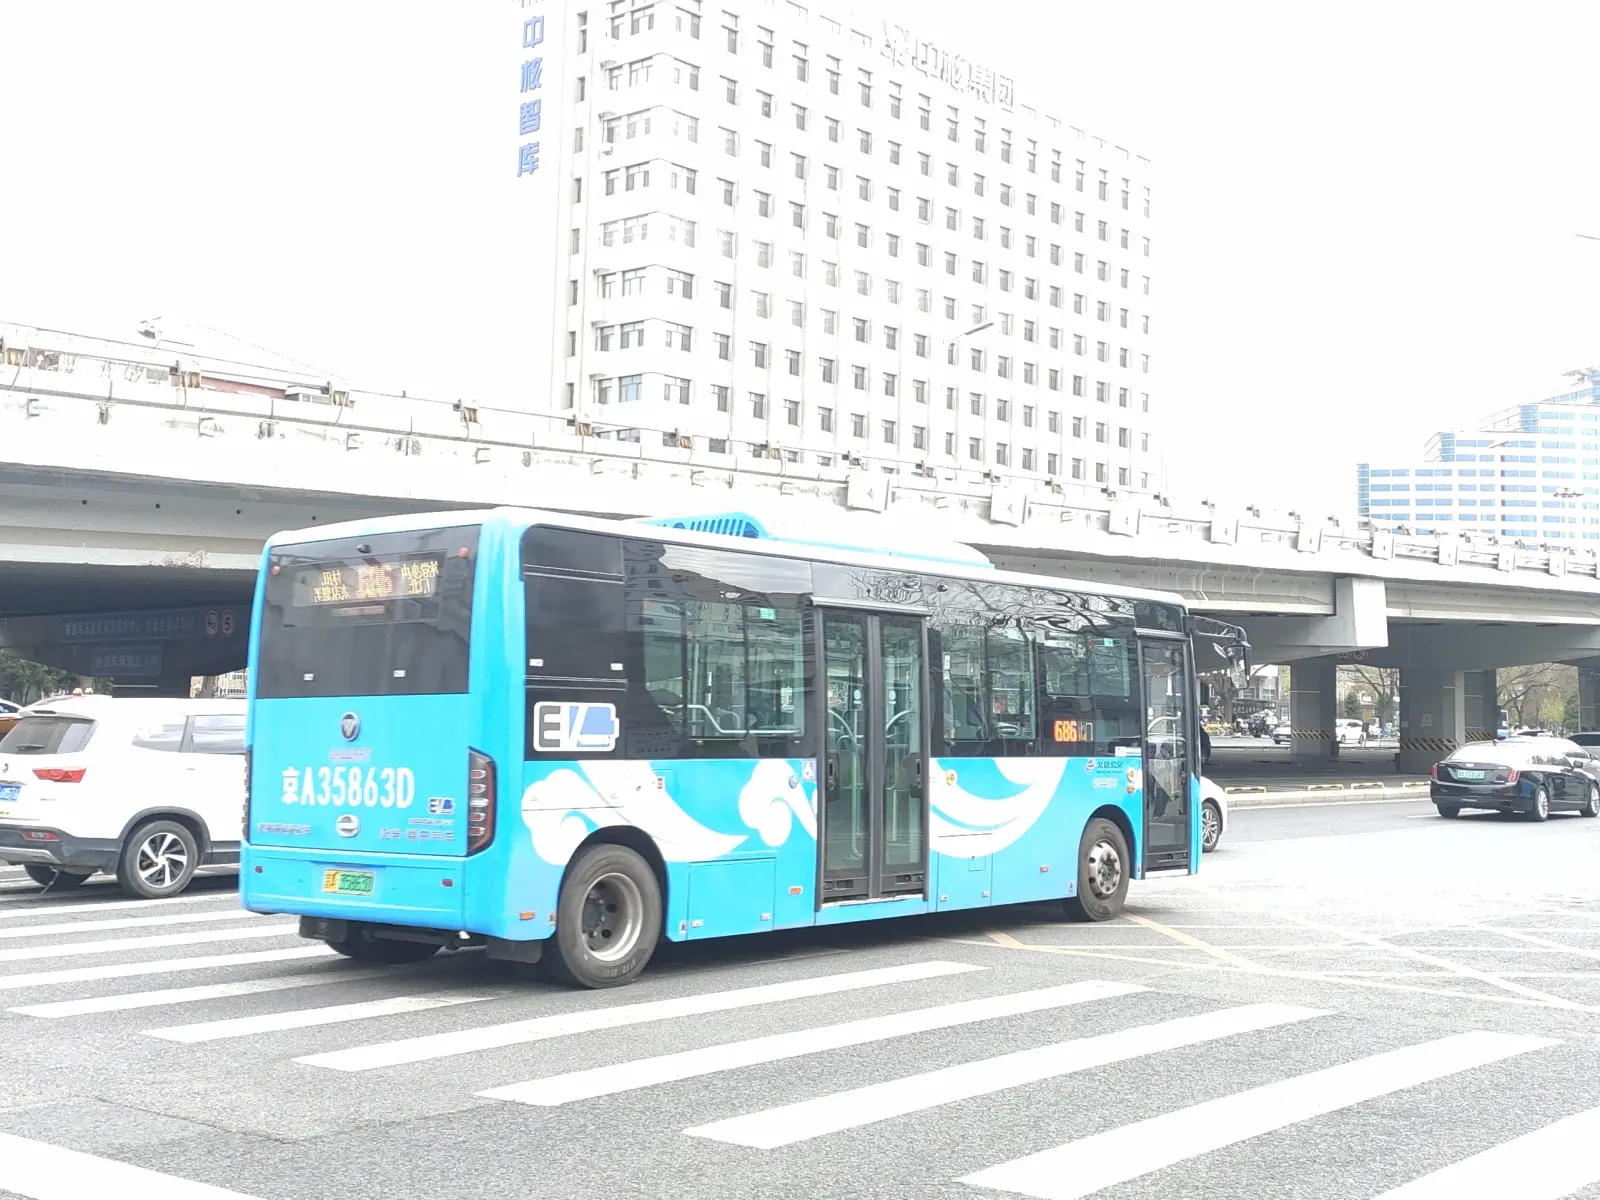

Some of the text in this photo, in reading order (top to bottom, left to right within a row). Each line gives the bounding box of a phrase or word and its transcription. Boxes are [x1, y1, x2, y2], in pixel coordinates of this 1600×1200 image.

[517, 15, 545, 178] 中核智库
[1054, 720, 1078, 742] 686
[281, 766, 415, 808] 京A35863D
